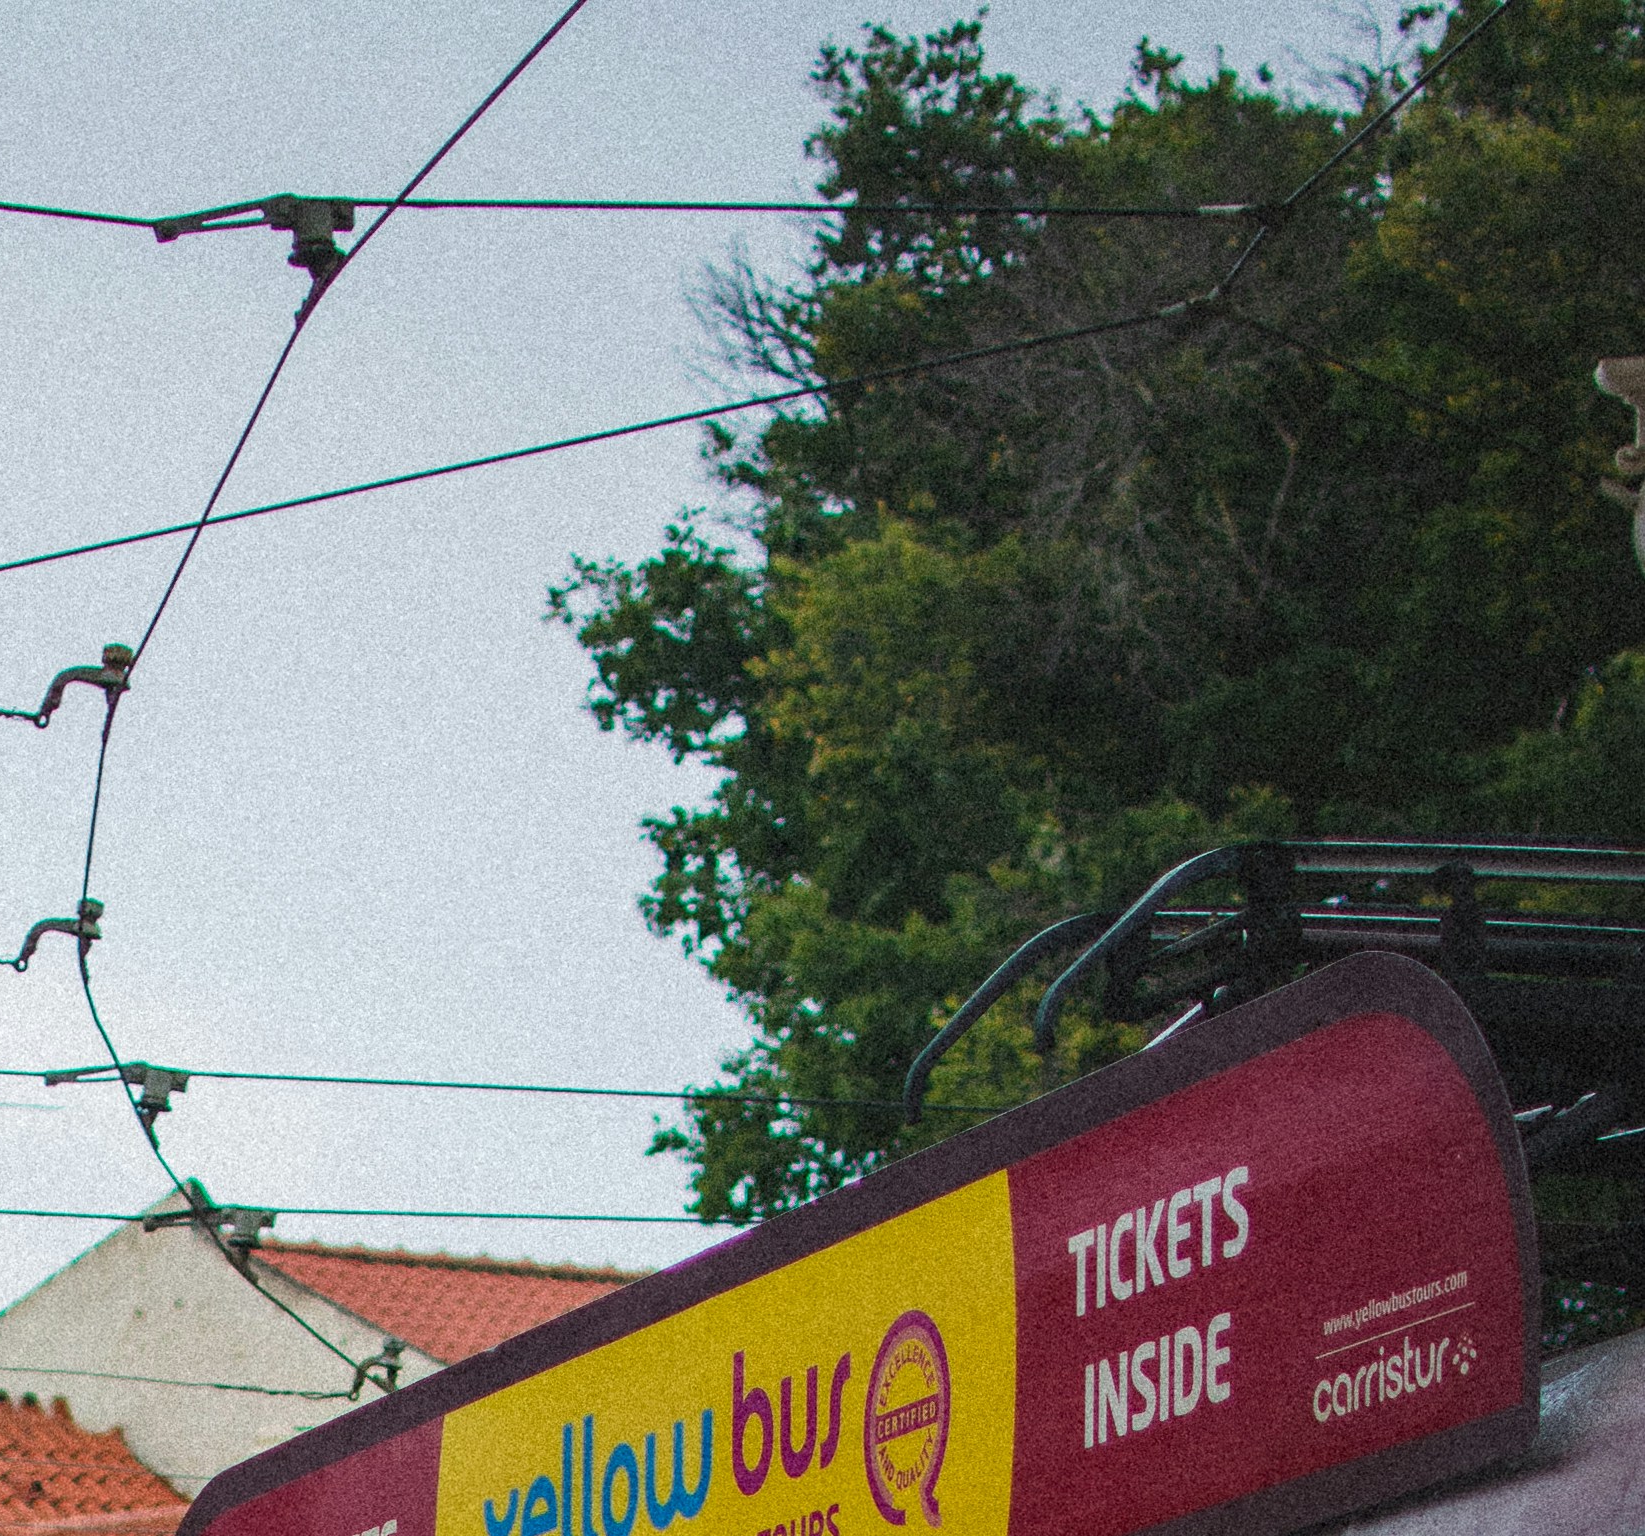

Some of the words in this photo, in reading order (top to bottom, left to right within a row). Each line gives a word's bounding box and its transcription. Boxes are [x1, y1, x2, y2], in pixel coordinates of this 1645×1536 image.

[1067, 1166, 1250, 1317] TICKETS
[1323, 1270, 1467, 1336] www.yellowbustours.com
[879, 1343, 936, 1407] EXCELLENCE
[1084, 1312, 1232, 1449] INSIDE
[1313, 1336, 1450, 1423] carristur
[730, 1349, 853, 1496] bus
[877, 1400, 938, 1439] CERTIFIED
[879, 1446, 895, 1482] AND
[896, 1428, 935, 1491] QUALITY
